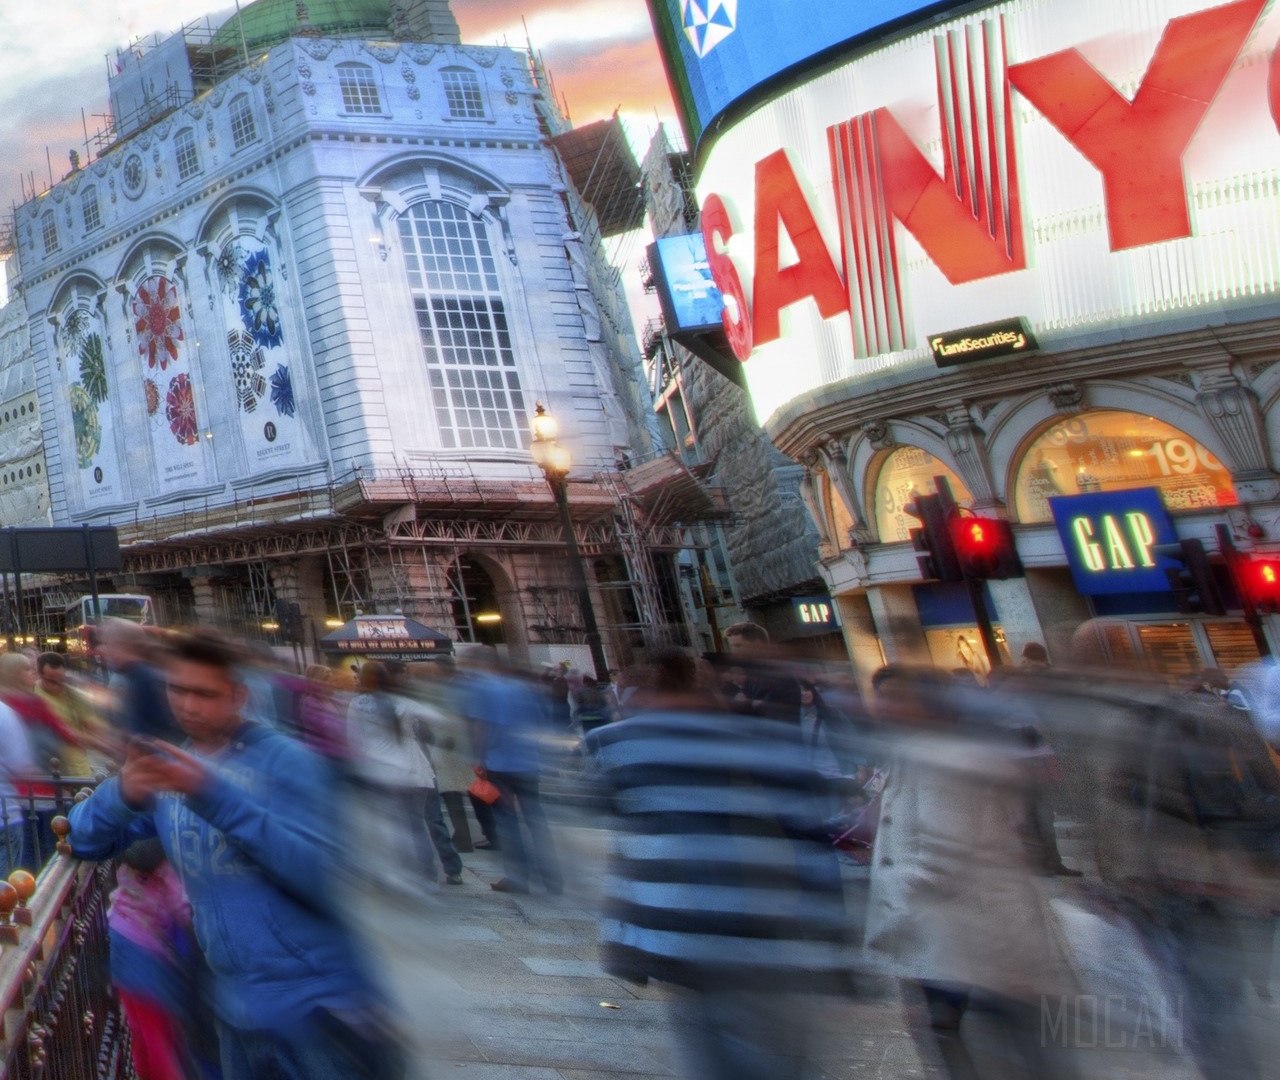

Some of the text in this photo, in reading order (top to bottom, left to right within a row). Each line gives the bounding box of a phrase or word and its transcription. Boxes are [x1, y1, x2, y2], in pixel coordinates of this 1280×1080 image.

[940, 331, 1017, 356] LandSecurities
[1071, 512, 1157, 573] GAP
[799, 603, 829, 622] GAP
[351, 641, 366, 649] WILL
[381, 641, 397, 649] WILL
[421, 641, 436, 649] YOU
